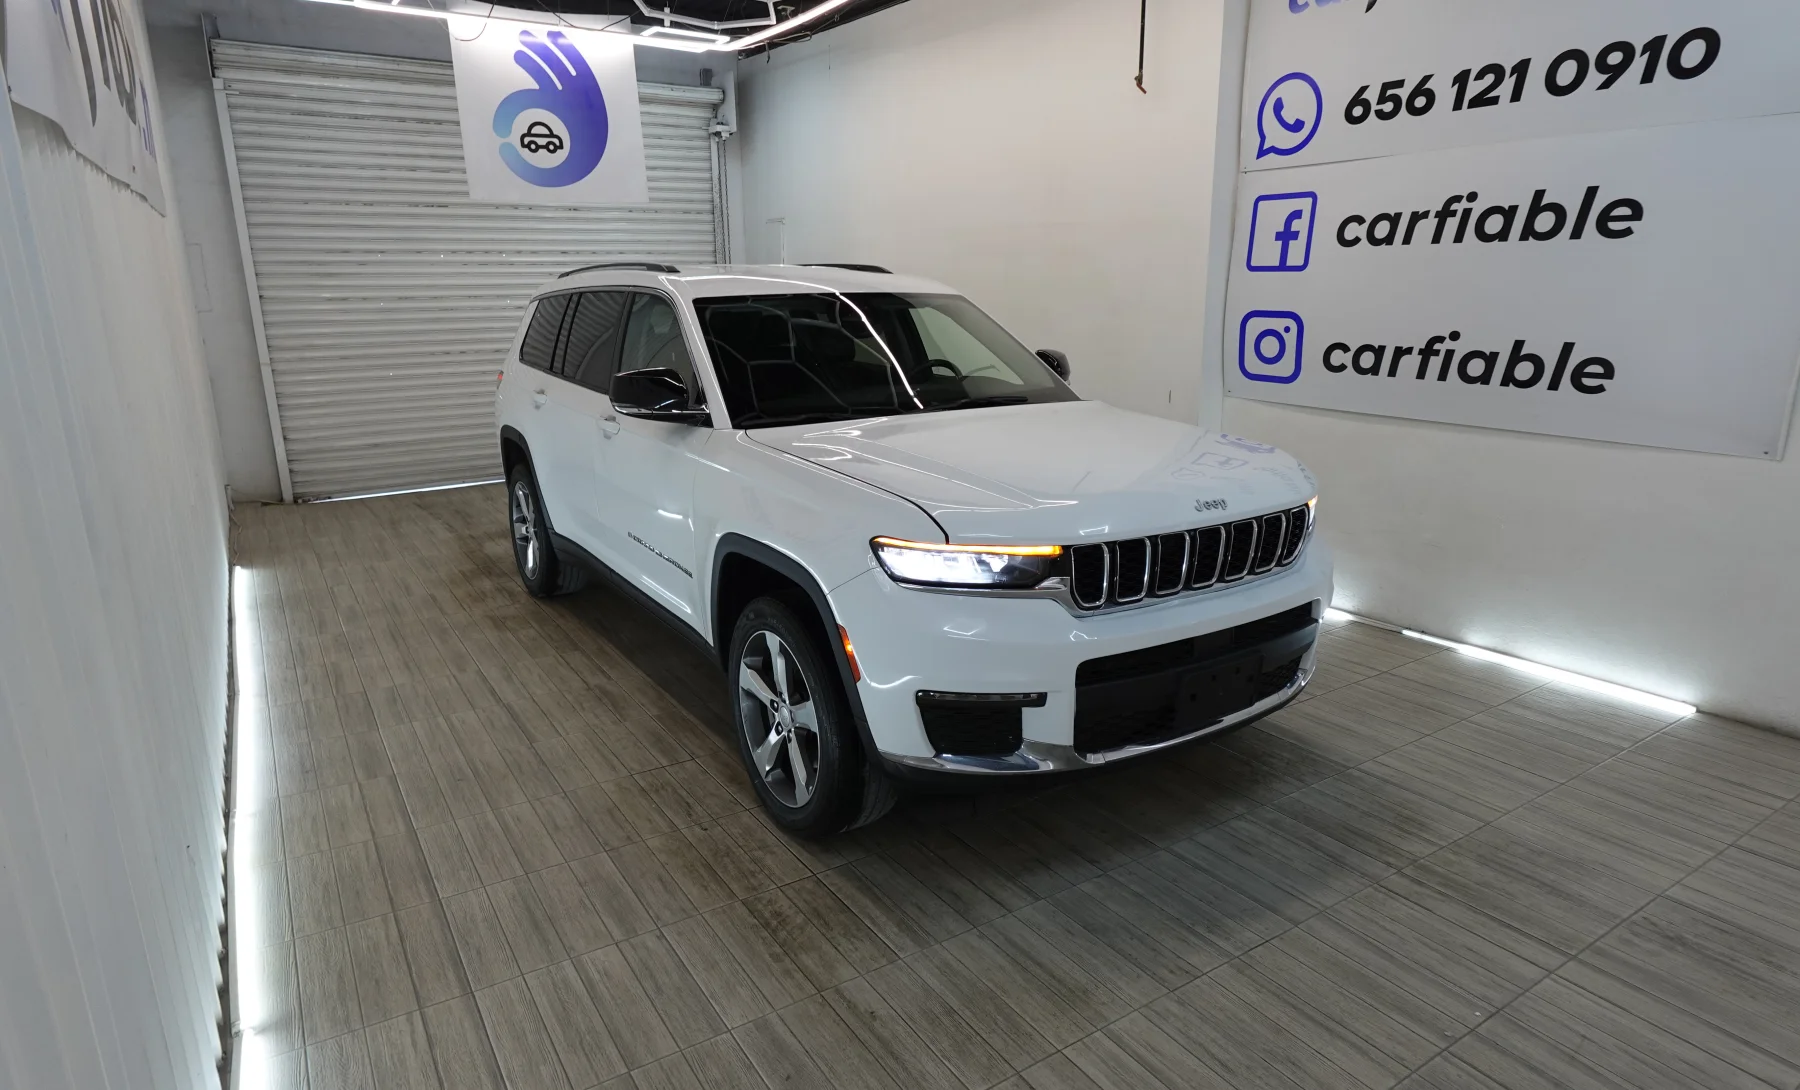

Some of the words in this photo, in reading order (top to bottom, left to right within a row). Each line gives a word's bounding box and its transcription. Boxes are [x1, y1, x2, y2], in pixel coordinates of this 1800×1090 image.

[1343, 73, 1436, 126] 656
[1450, 57, 1532, 112] 121
[1544, 26, 1721, 97] 0910
[1336, 185, 1644, 248] carfiable
[1322, 330, 1616, 395] carfiable
[1194, 498, 1228, 512] Jeep
